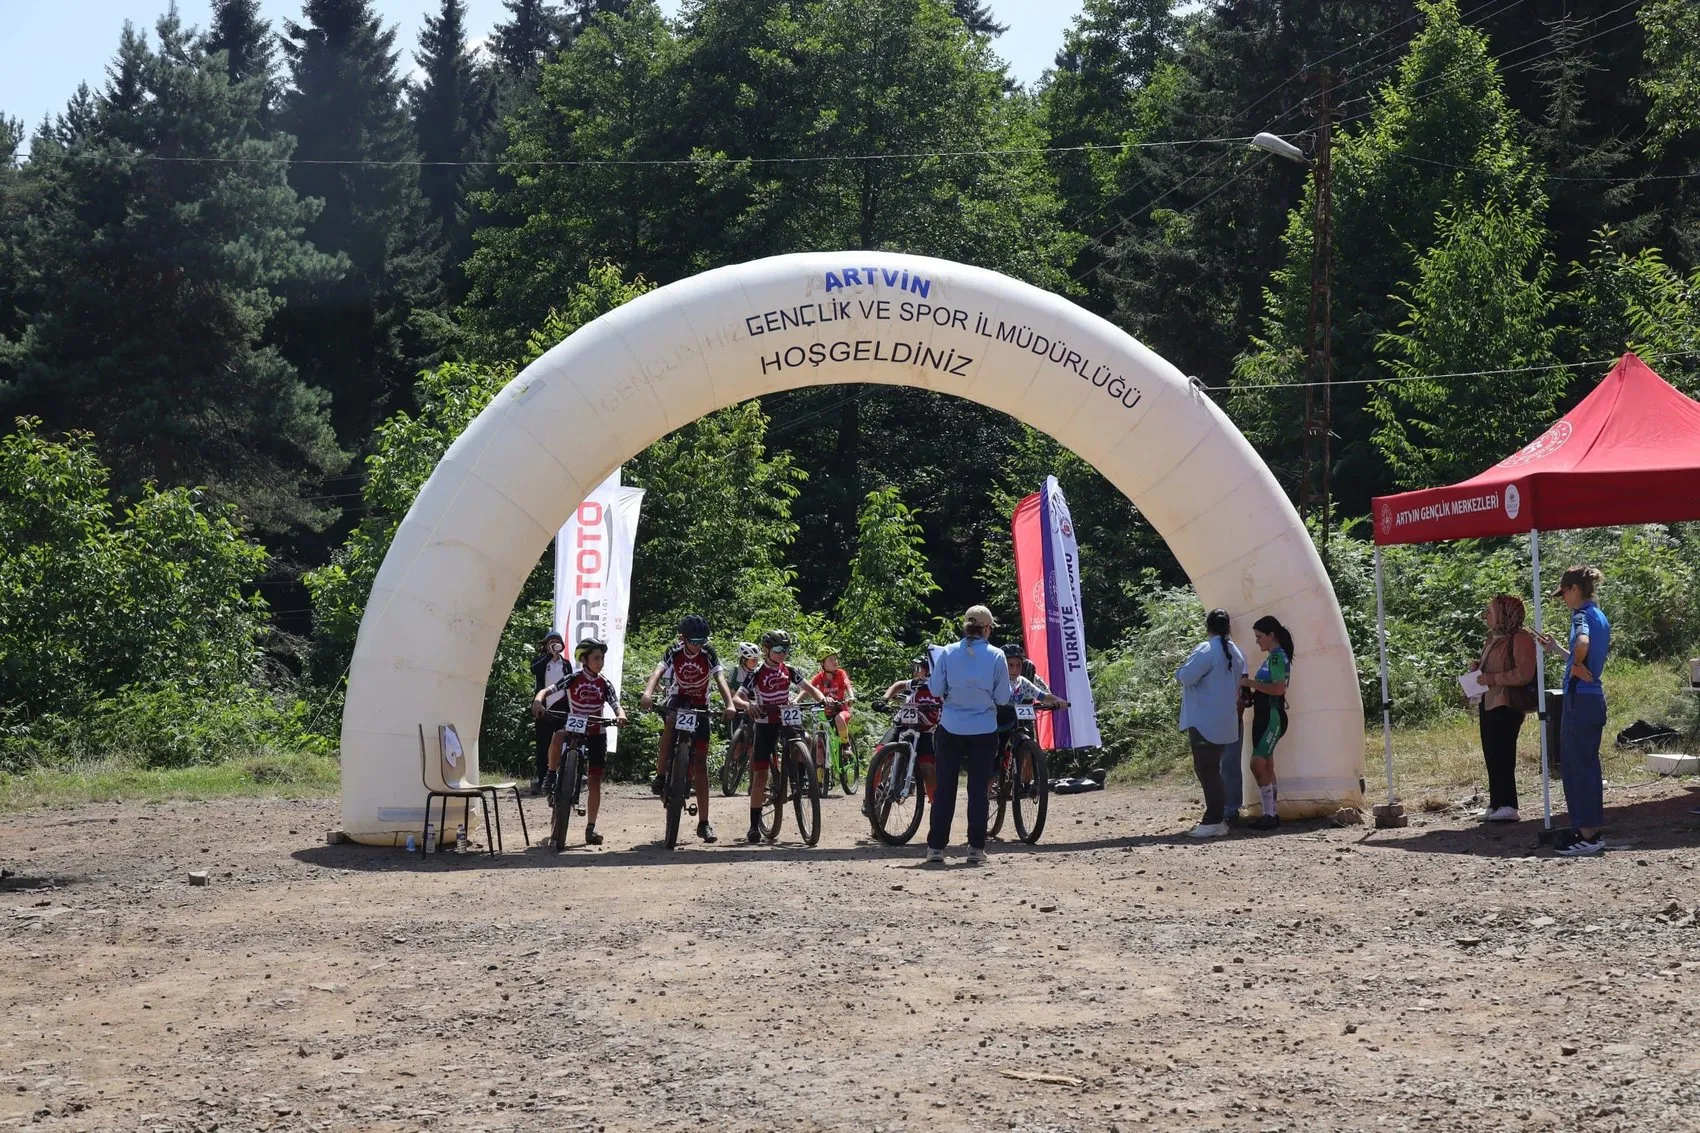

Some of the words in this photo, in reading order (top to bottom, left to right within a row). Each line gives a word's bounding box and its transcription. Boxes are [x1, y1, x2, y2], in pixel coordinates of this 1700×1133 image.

[825, 267, 931, 299] ARTVİN
[745, 298, 852, 336] GENÇLİK
[858, 300, 891, 320] VE
[899, 302, 969, 331] SPOR
[760, 341, 974, 377] HOŞGELDİNİZ
[1420, 500, 1450, 521] GENÇLİK
[1451, 491, 1500, 515] MERKEZLERİ
[576, 501, 603, 597] TOTO
[1061, 605, 1081, 672] TÜRKİYE
[568, 717, 584, 729] 23
[678, 714, 694, 726] 24
[783, 709, 799, 720] 22
[903, 708, 916, 718] 25
[1018, 707, 1033, 716] 21
